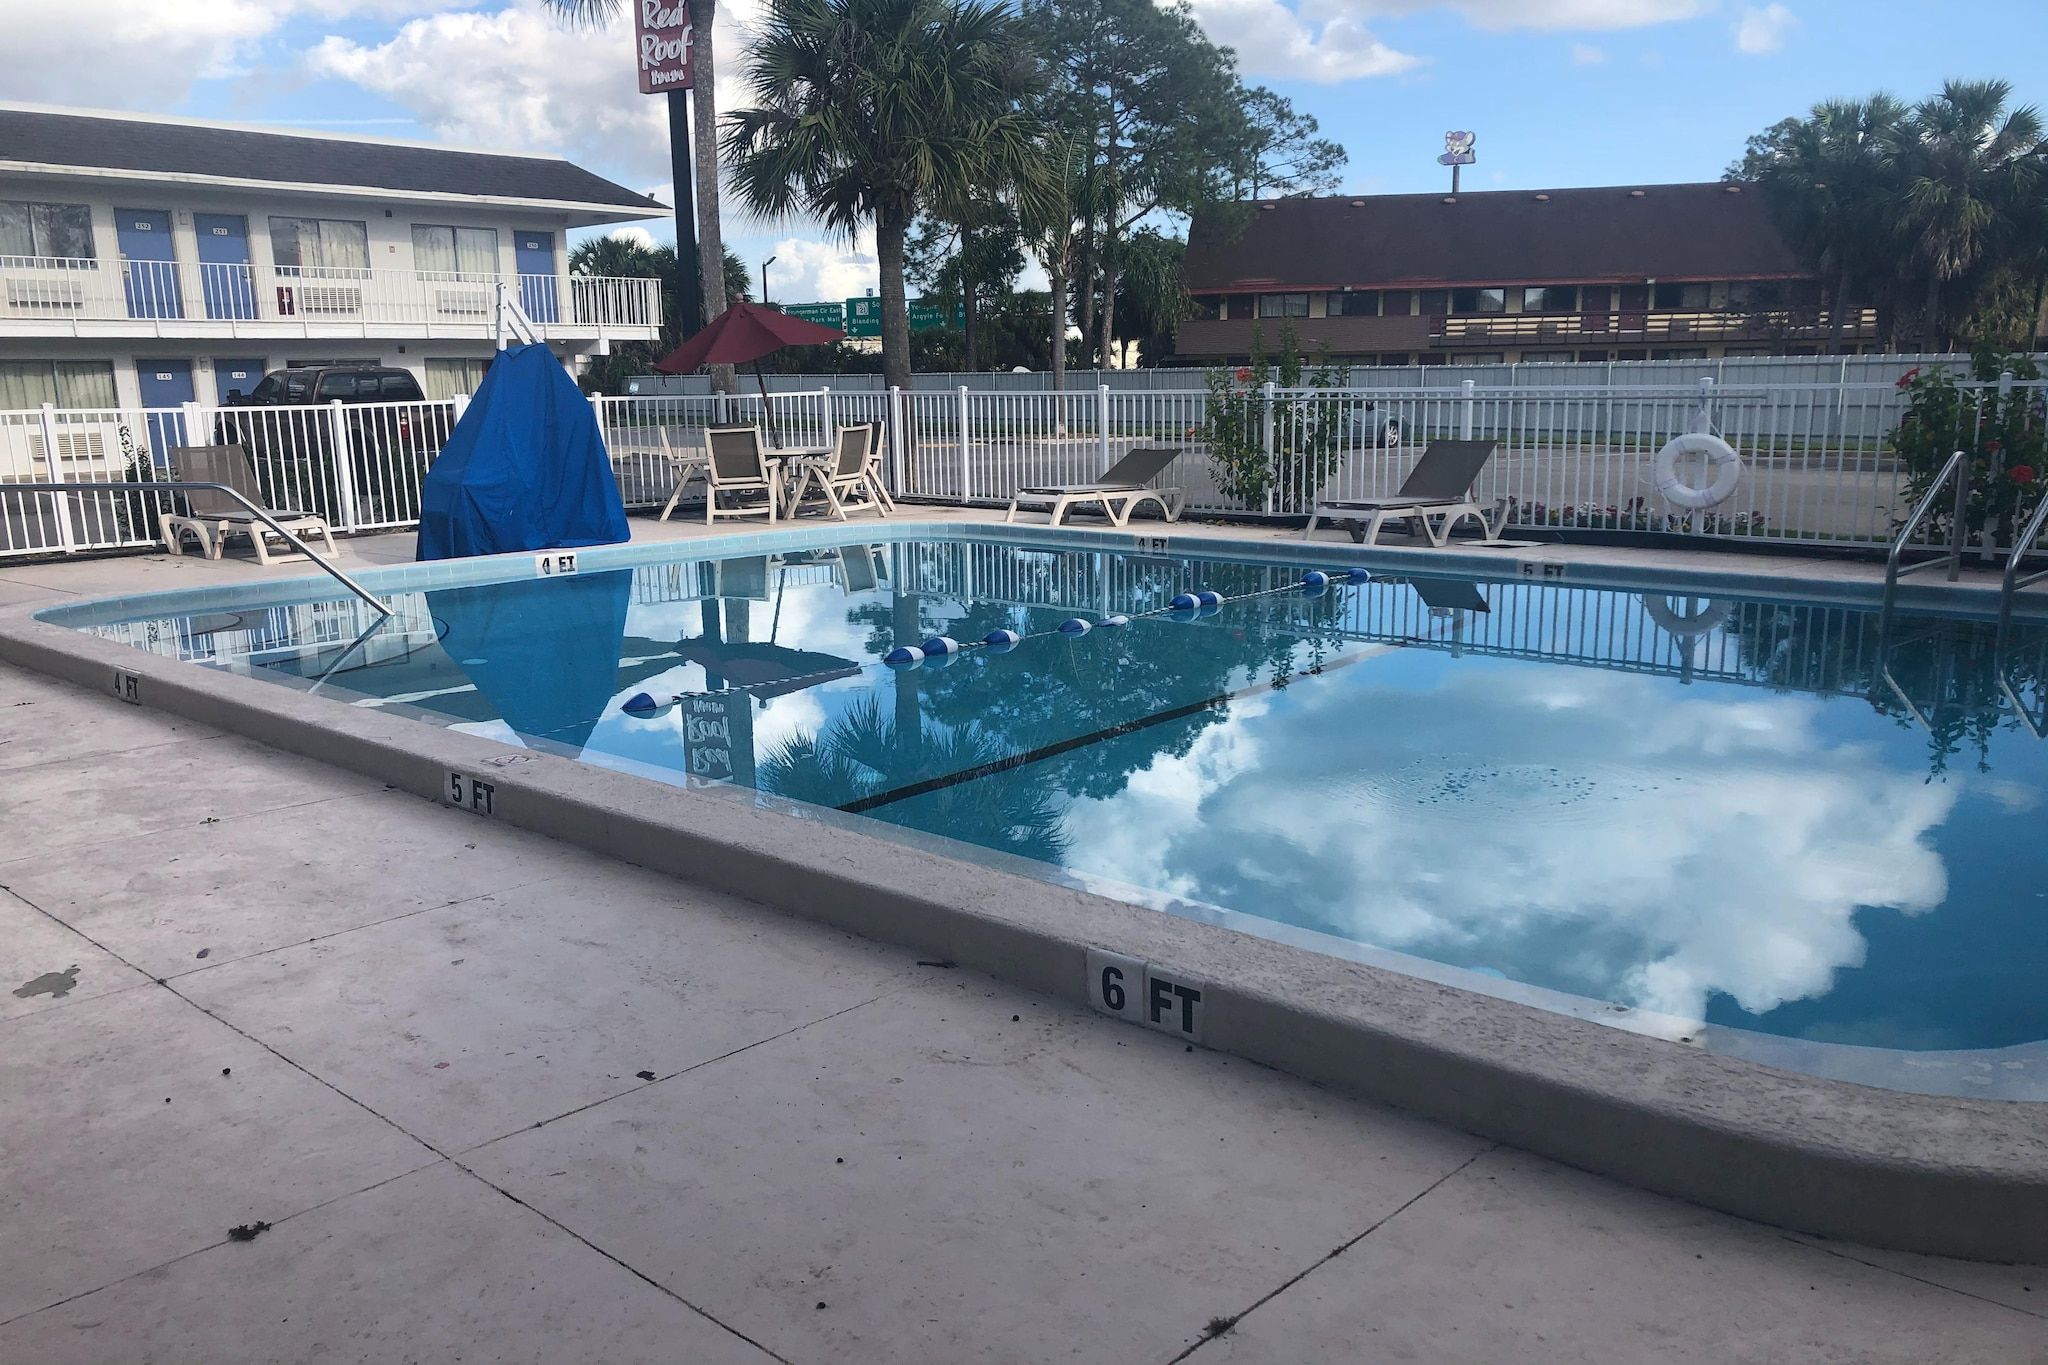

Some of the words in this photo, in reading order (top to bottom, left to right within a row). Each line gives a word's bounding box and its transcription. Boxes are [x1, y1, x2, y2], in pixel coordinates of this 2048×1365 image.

[641, 0, 684, 30] Red
[640, 24, 694, 71] Roof
[114, 671, 121, 695] 4
[126, 675, 138, 700] FT
[451, 772, 463, 803] 5
[472, 779, 495, 815] FT
[1101, 966, 1126, 1011] 6
[1150, 977, 1201, 1034] FT
